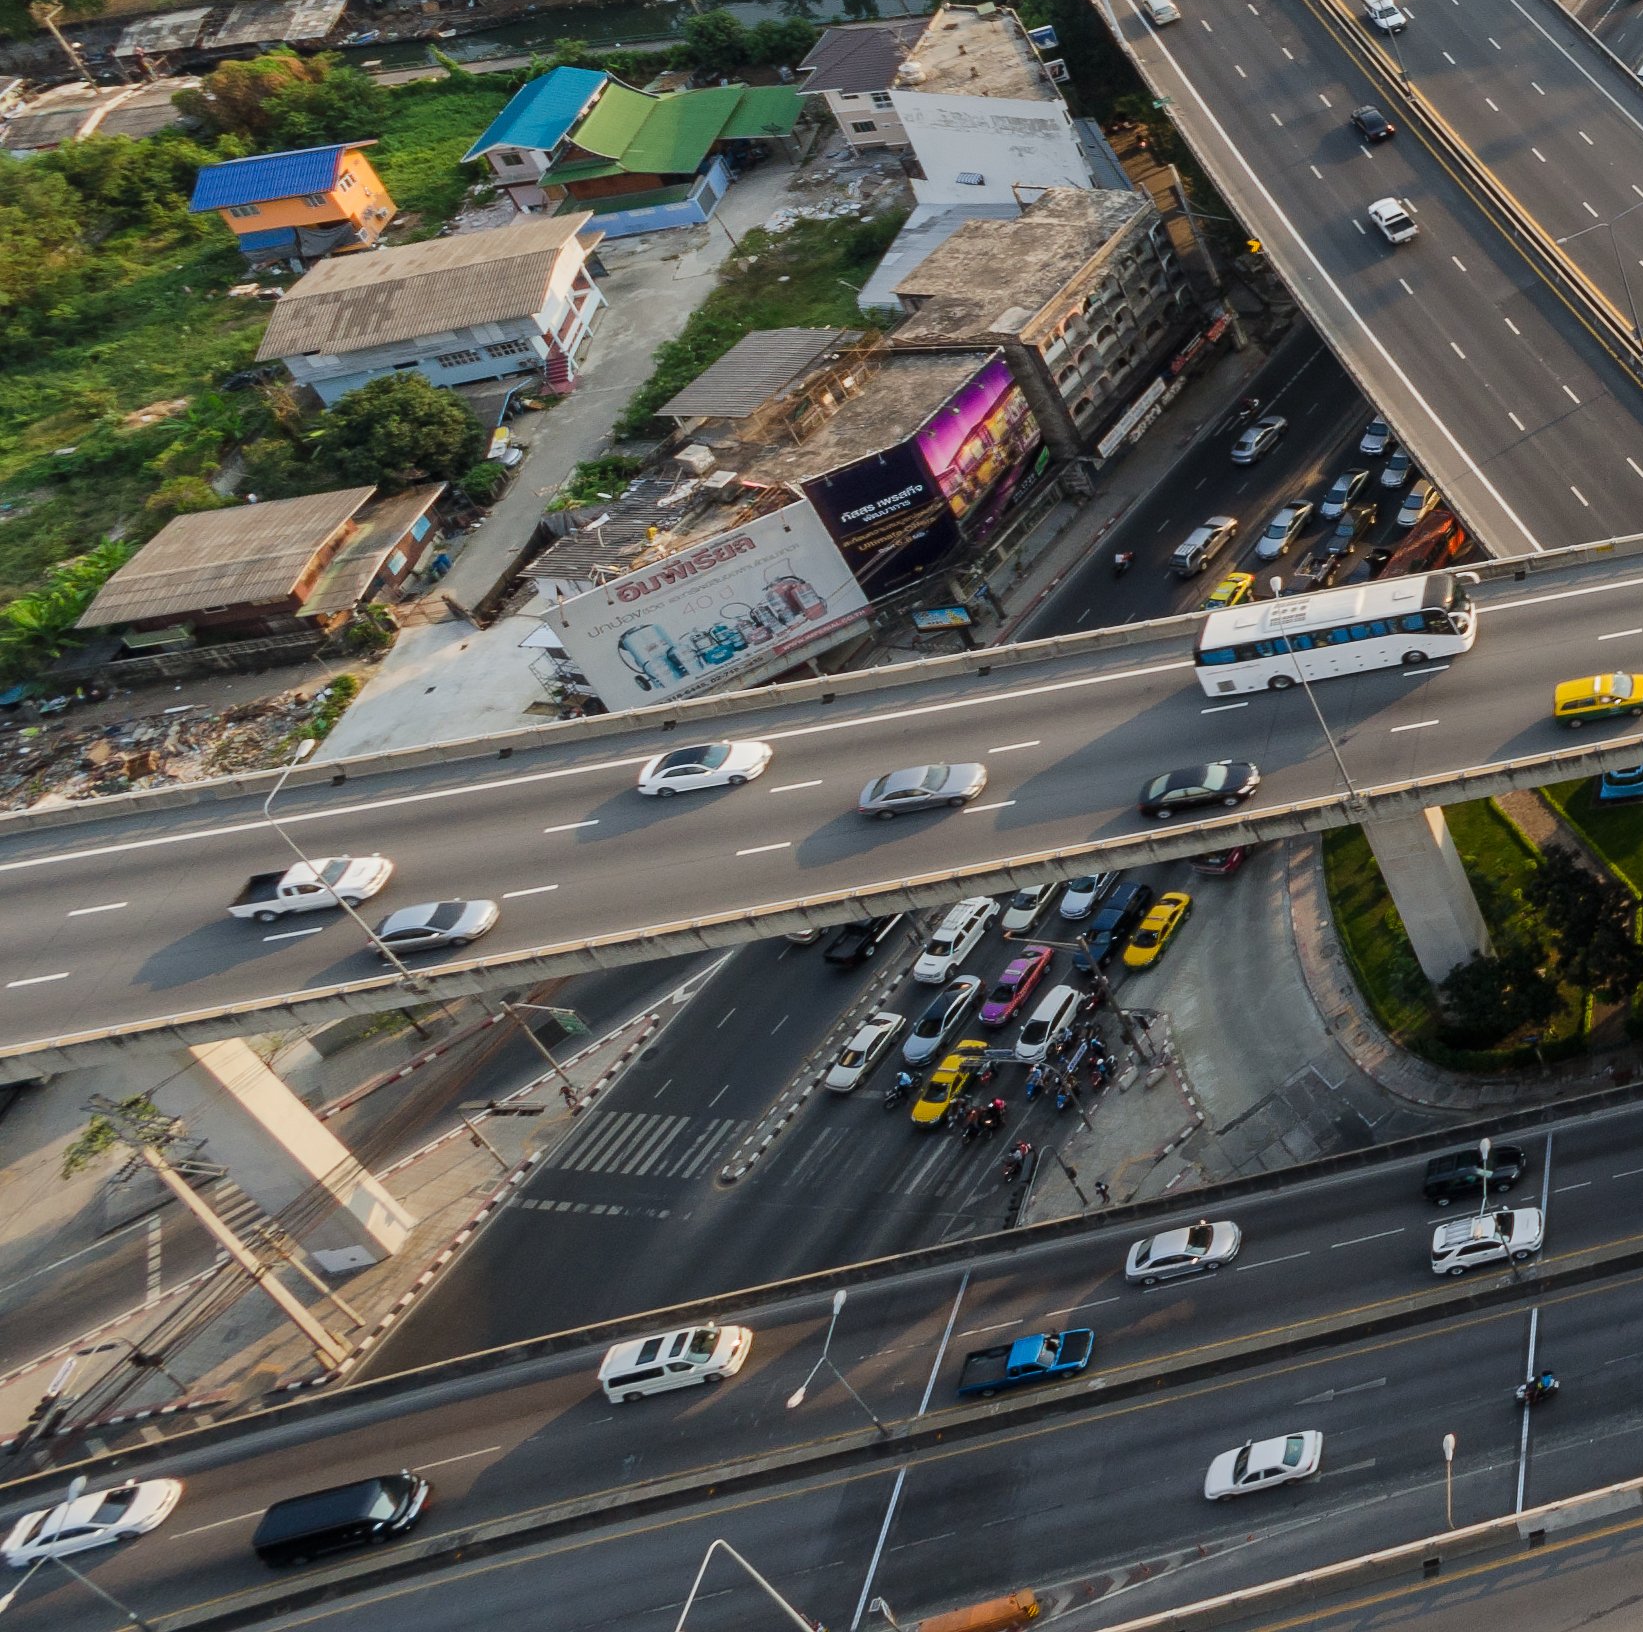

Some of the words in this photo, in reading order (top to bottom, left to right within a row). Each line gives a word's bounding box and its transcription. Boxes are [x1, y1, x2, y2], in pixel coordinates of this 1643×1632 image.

[840, 503, 876, 523] ภัสสร
[862, 500, 911, 522] พัฒนาการ
[614, 536, 757, 603] อิมพีเรียล
